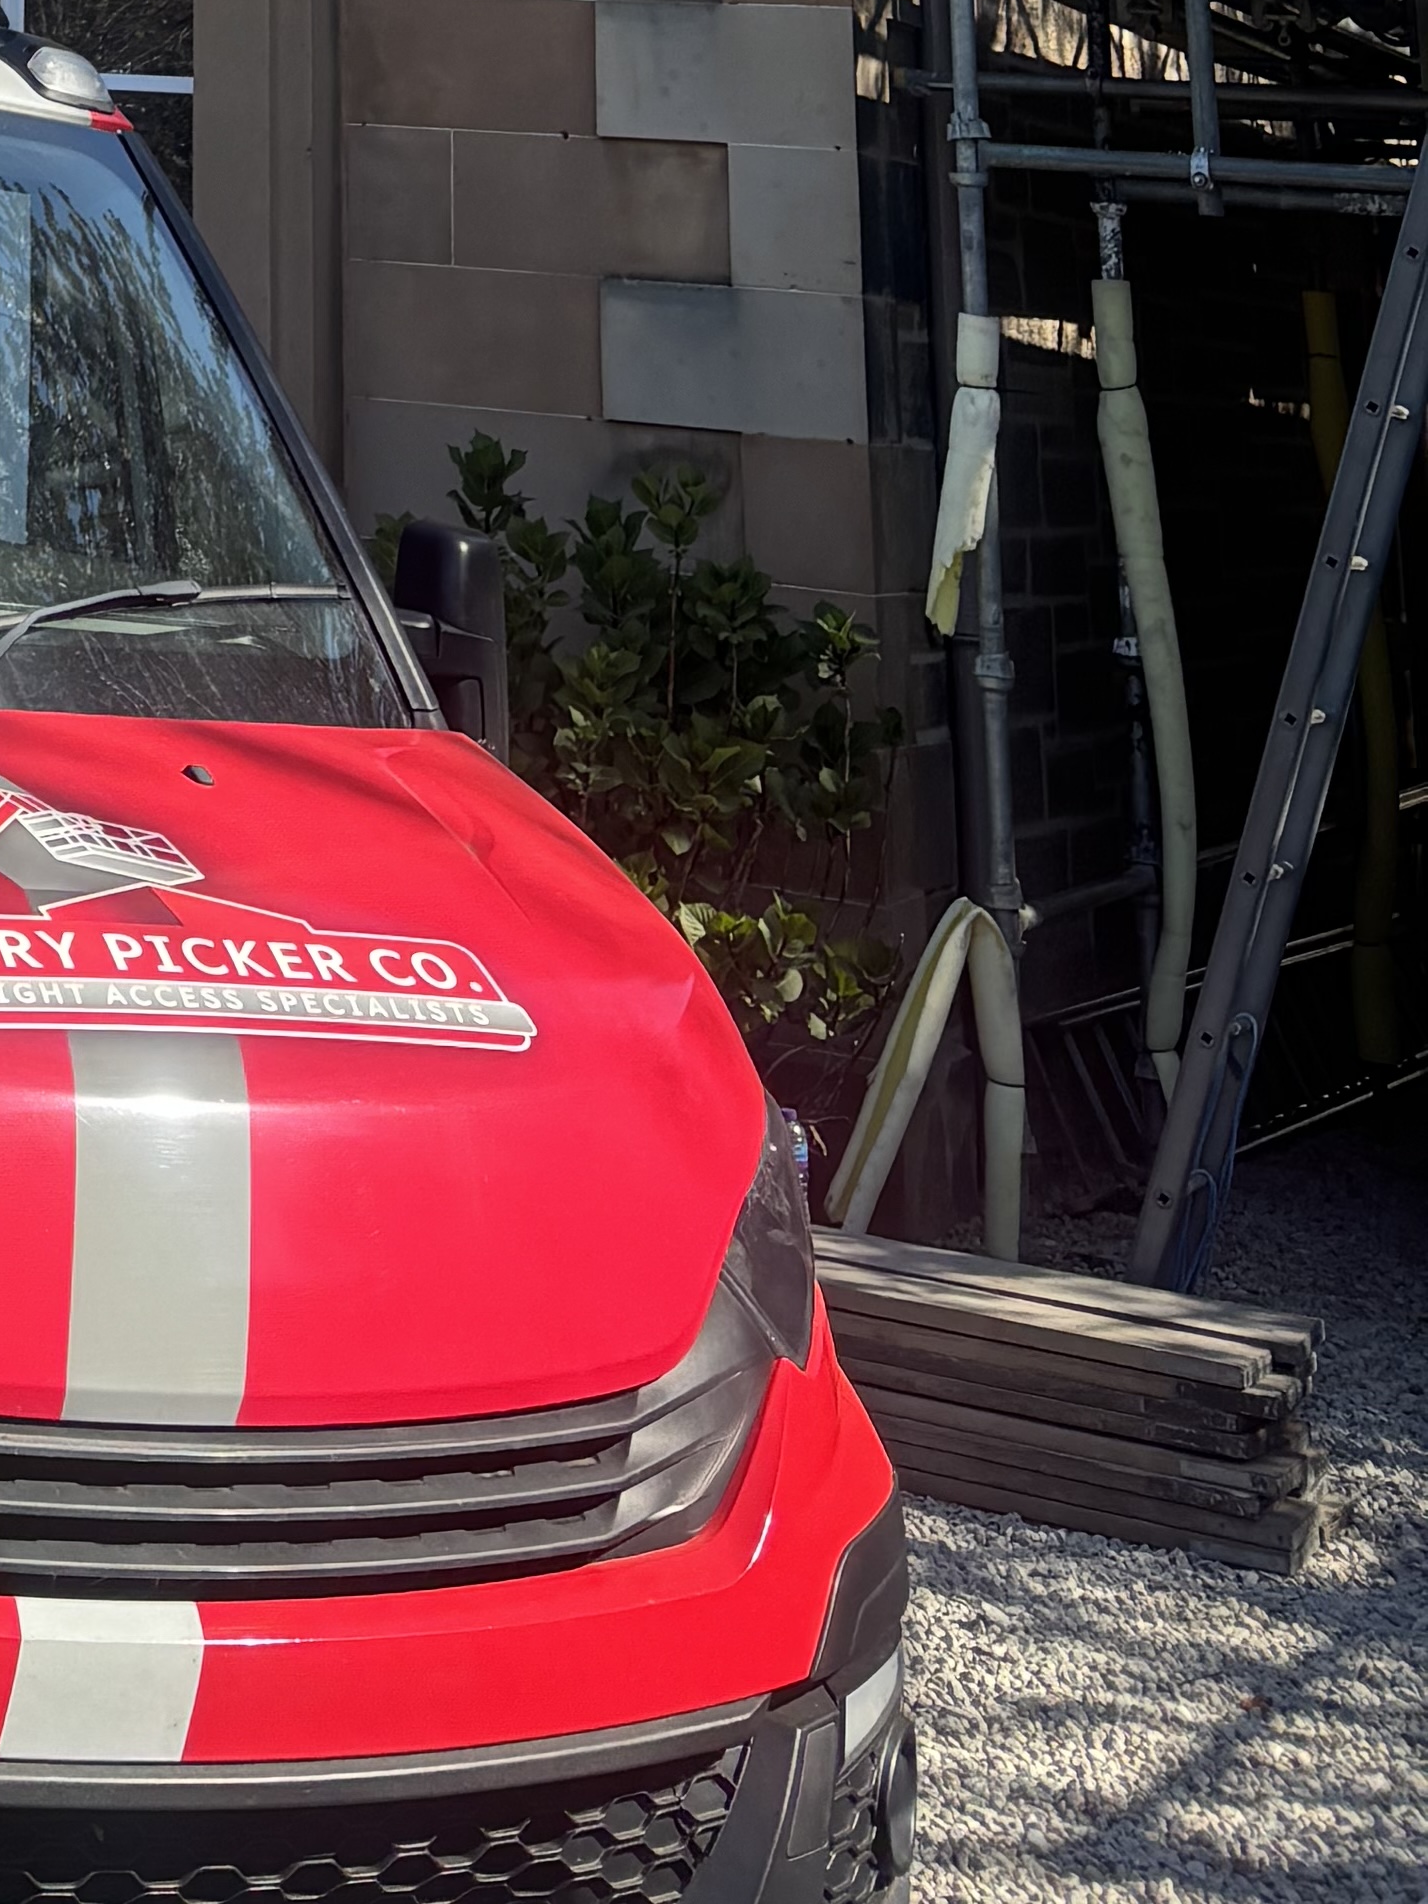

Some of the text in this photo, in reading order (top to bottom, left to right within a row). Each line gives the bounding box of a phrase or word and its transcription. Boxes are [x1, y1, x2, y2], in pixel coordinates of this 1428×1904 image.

[102, 932, 358, 983] PICKER
[368, 948, 484, 993] CO.
[106, 983, 244, 1010] ACCESS
[259, 990, 492, 1026] SPECIALISTS
